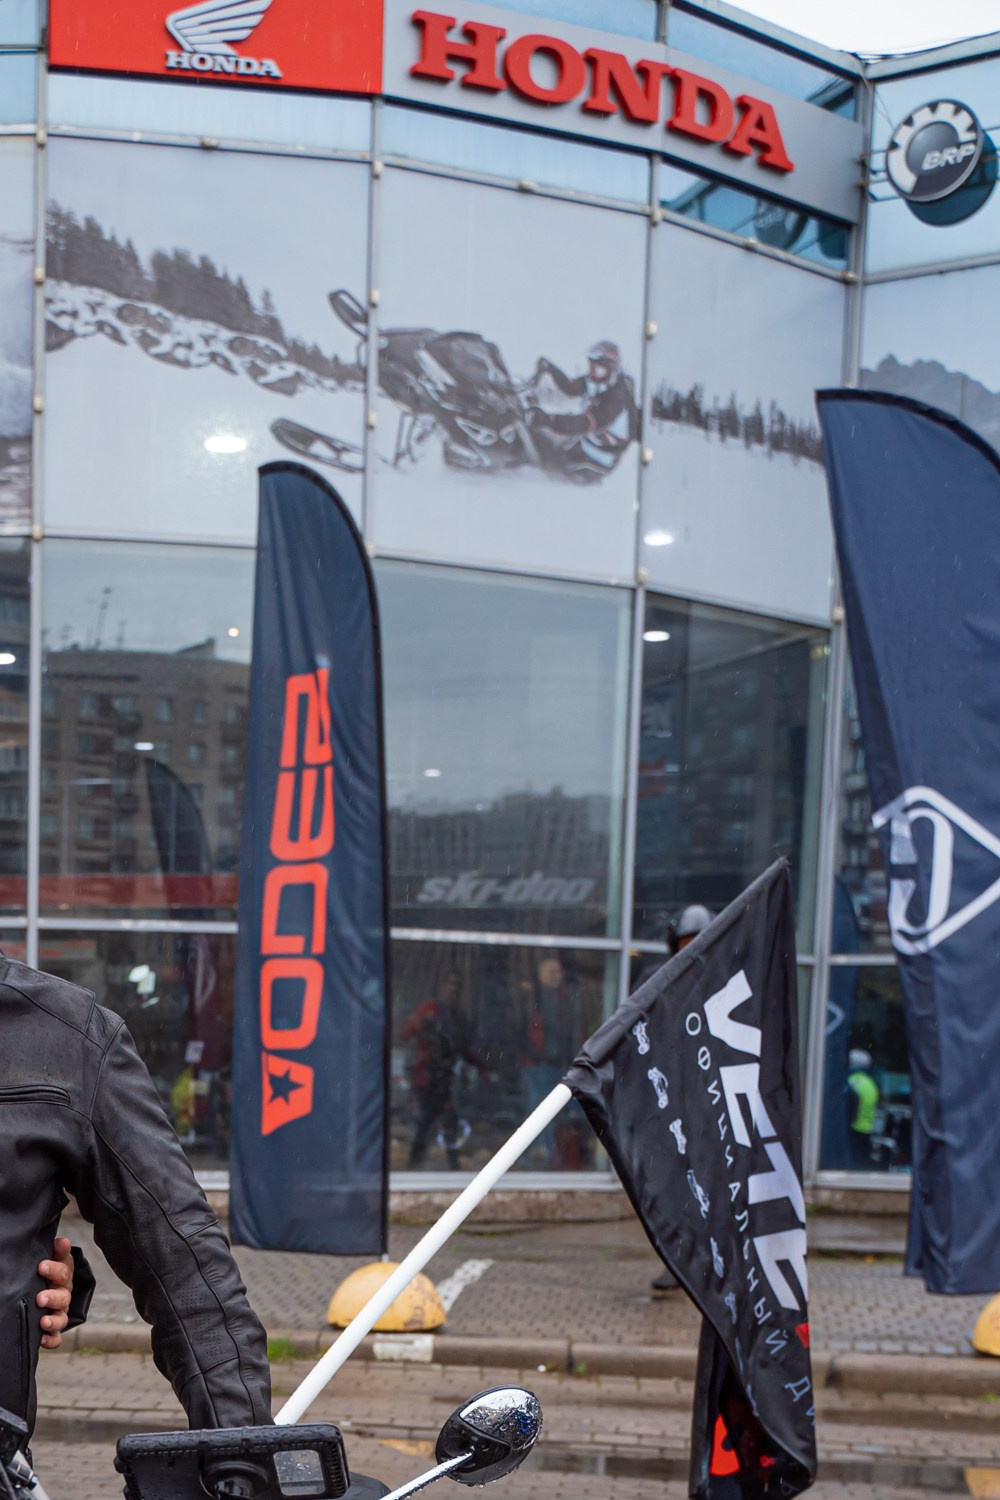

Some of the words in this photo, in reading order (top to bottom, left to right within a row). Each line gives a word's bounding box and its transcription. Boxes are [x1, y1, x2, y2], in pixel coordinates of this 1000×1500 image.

[165, 51, 283, 78] HONDA
[410, 9, 795, 174] HONDA
[921, 143, 976, 171] BRP
[686, 1012, 789, 1356] ОФИЦИАЛЬНЫЙ
